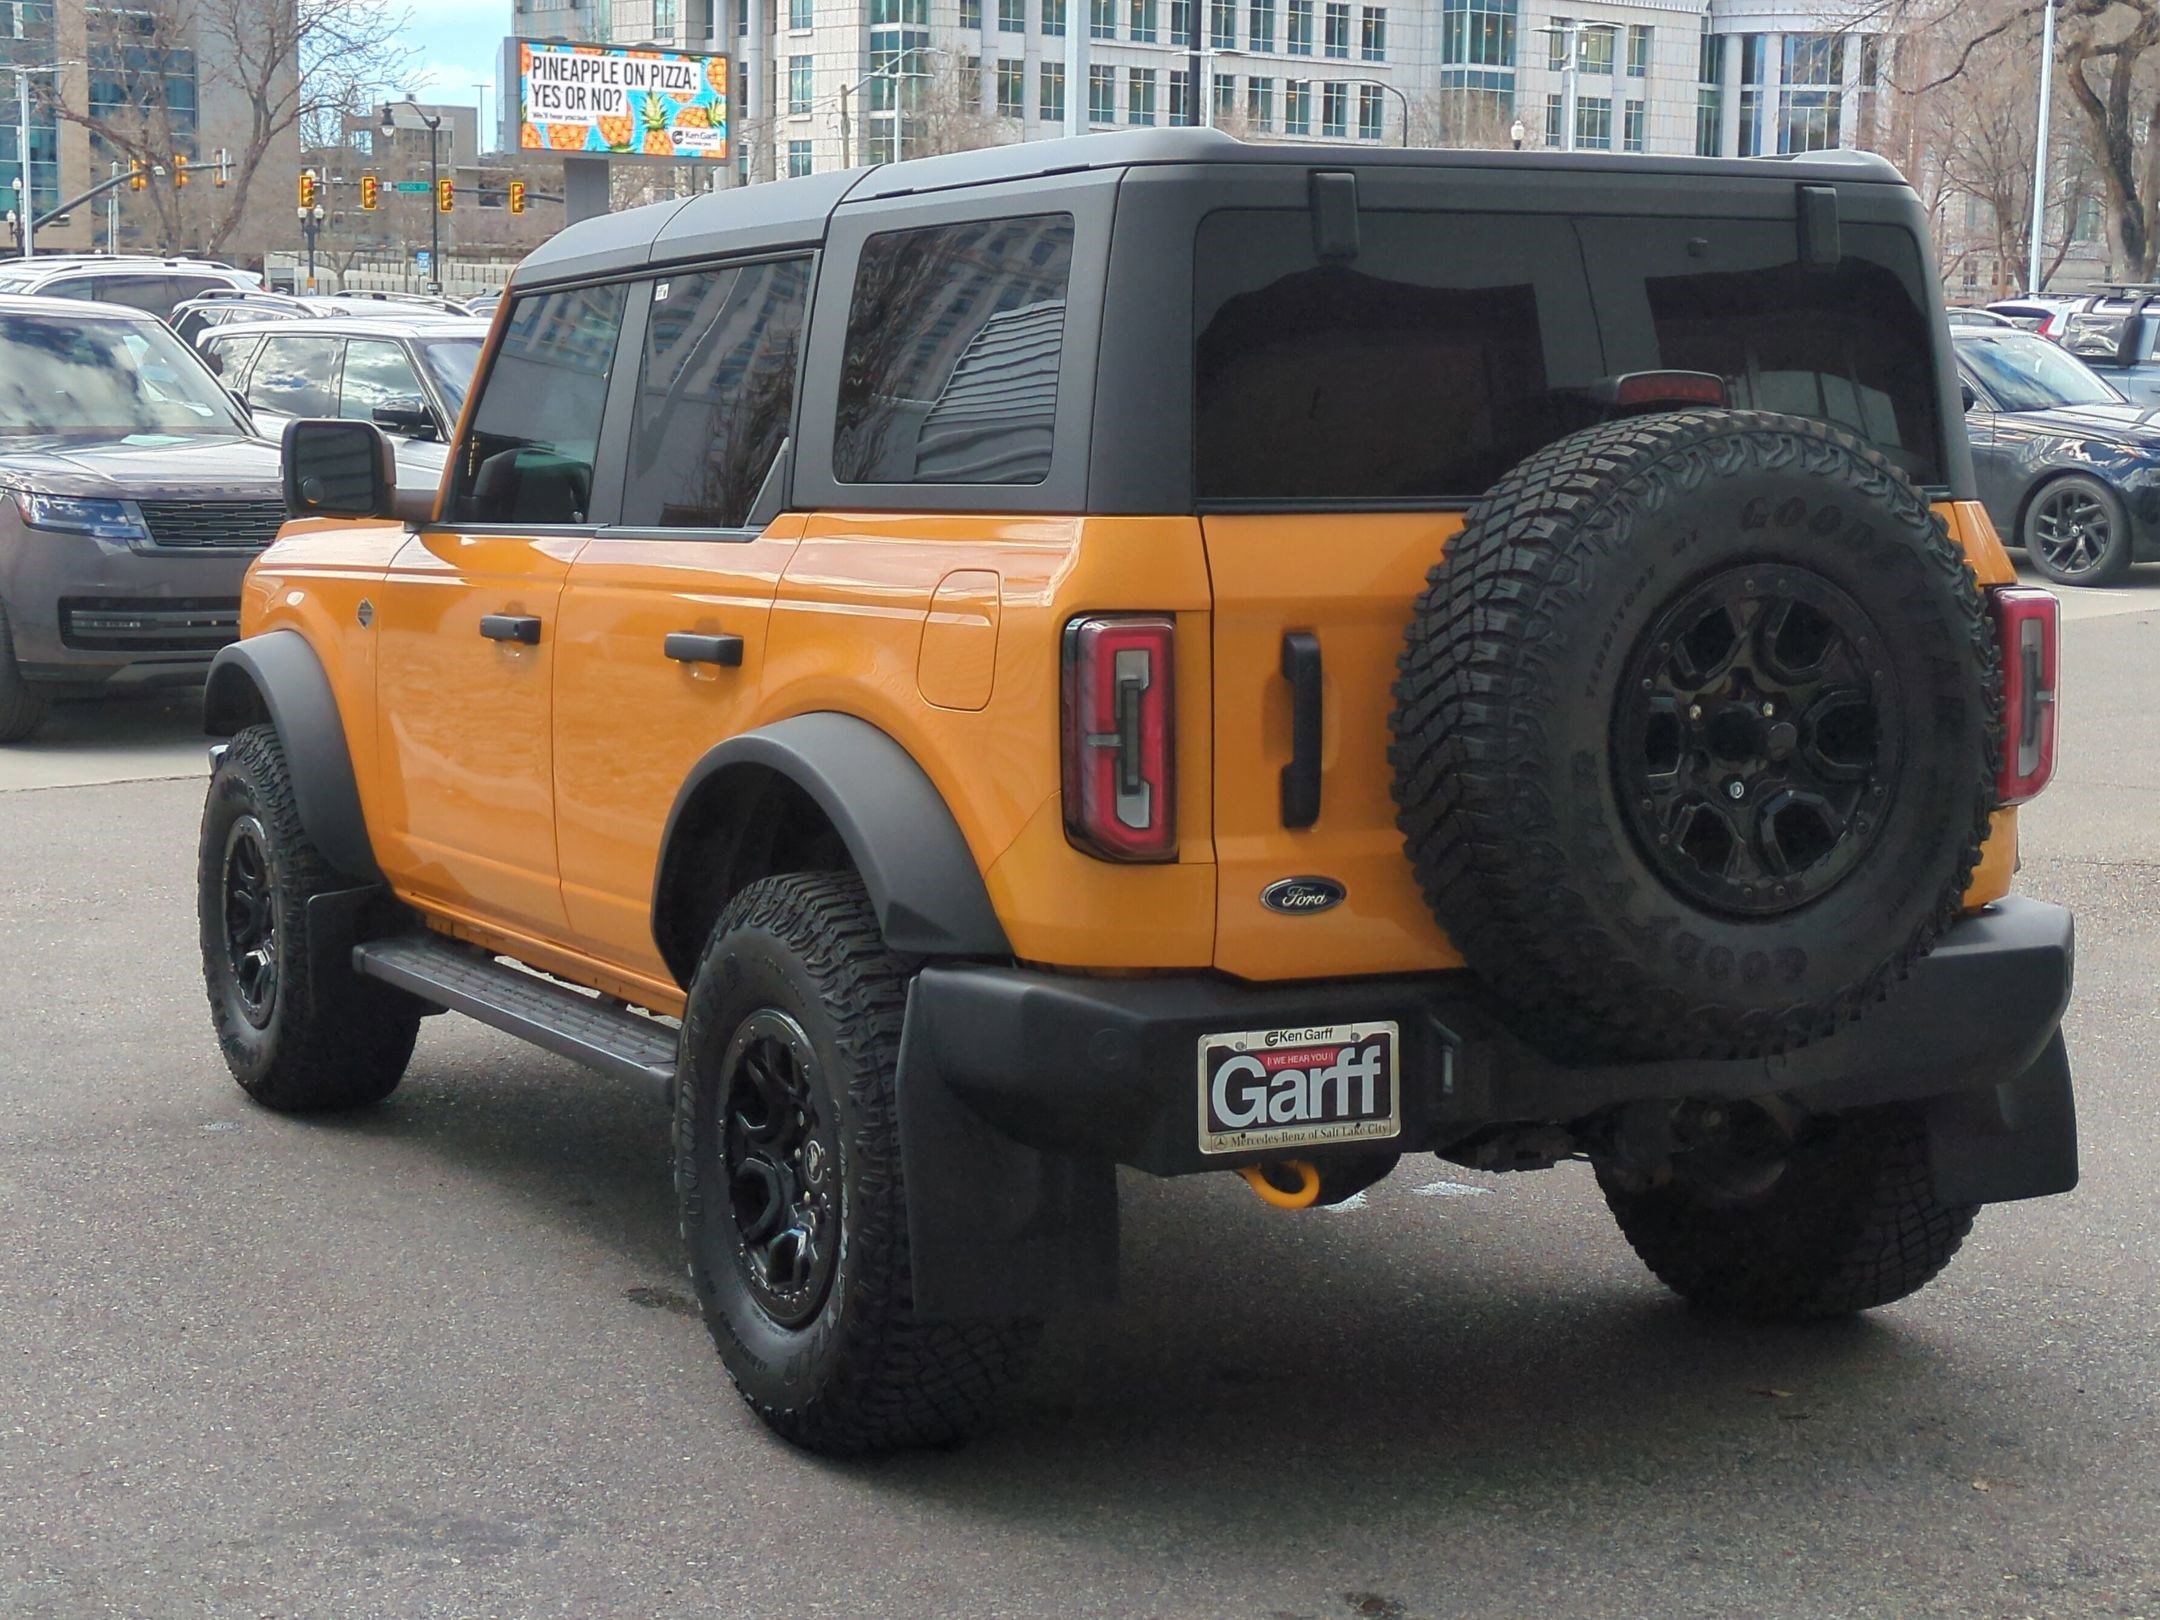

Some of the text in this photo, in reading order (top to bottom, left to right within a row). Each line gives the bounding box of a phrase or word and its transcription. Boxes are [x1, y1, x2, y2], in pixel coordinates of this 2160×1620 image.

[532, 55, 698, 90] PINEAPPLE ON PIZZA:
[531, 83, 622, 112] YES OR NO?
[1282, 885, 1327, 907] Ford
[1279, 1027, 1334, 1043] Ken Garff
[1273, 1053, 1329, 1065] WE HEAR YOU
[1211, 1045, 1381, 1128] Garff
[1231, 1122, 1388, 1147] Mercedes-Benz of Salt Lake City
